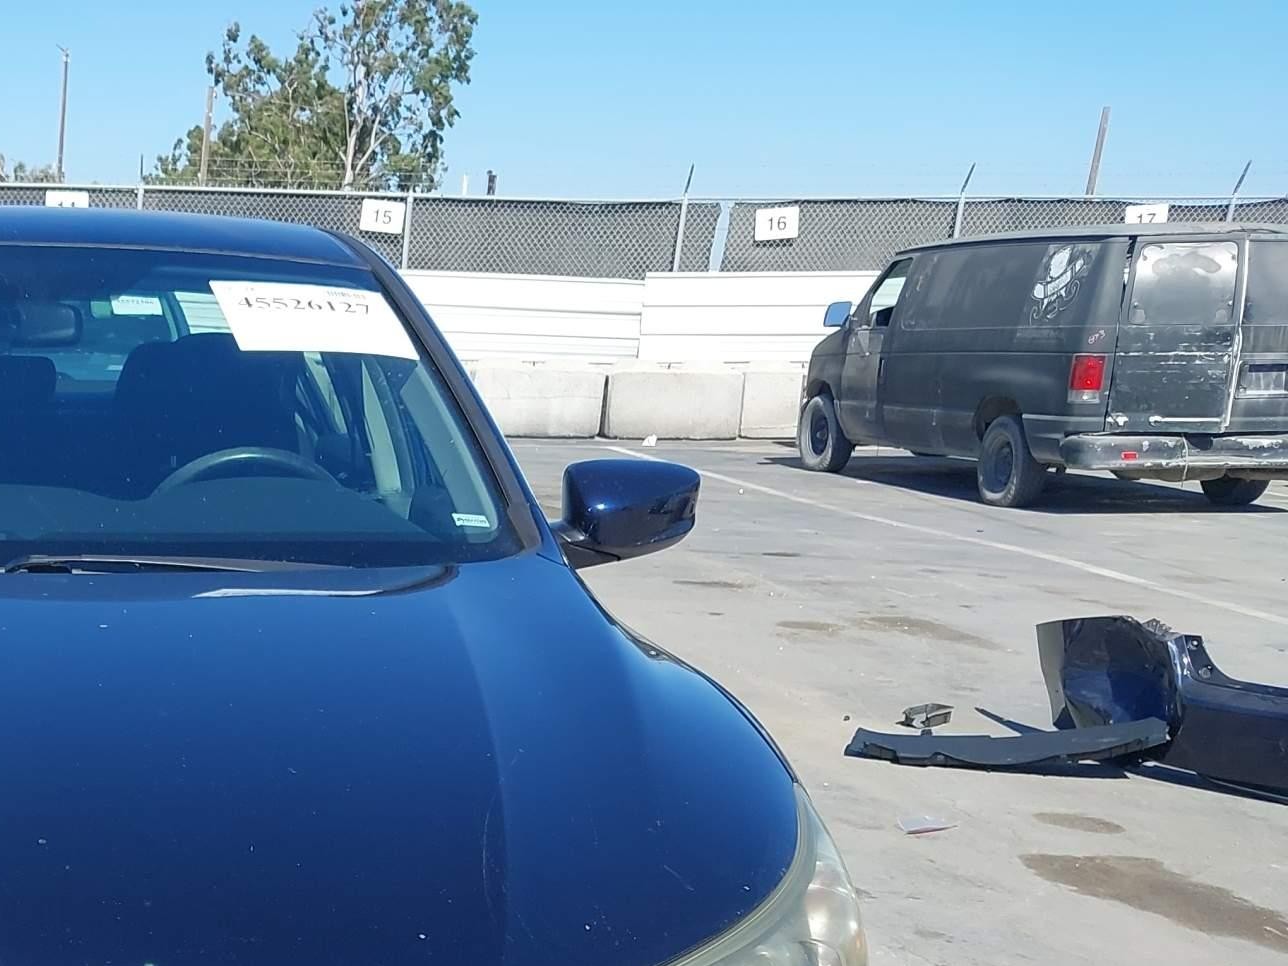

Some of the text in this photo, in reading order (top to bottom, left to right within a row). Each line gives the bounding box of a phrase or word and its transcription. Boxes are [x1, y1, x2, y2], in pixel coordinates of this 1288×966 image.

[374, 208, 393, 225] 15
[768, 215, 787, 231] 16
[1137, 212, 1157, 224] 17
[238, 296, 369, 316] 45526127
